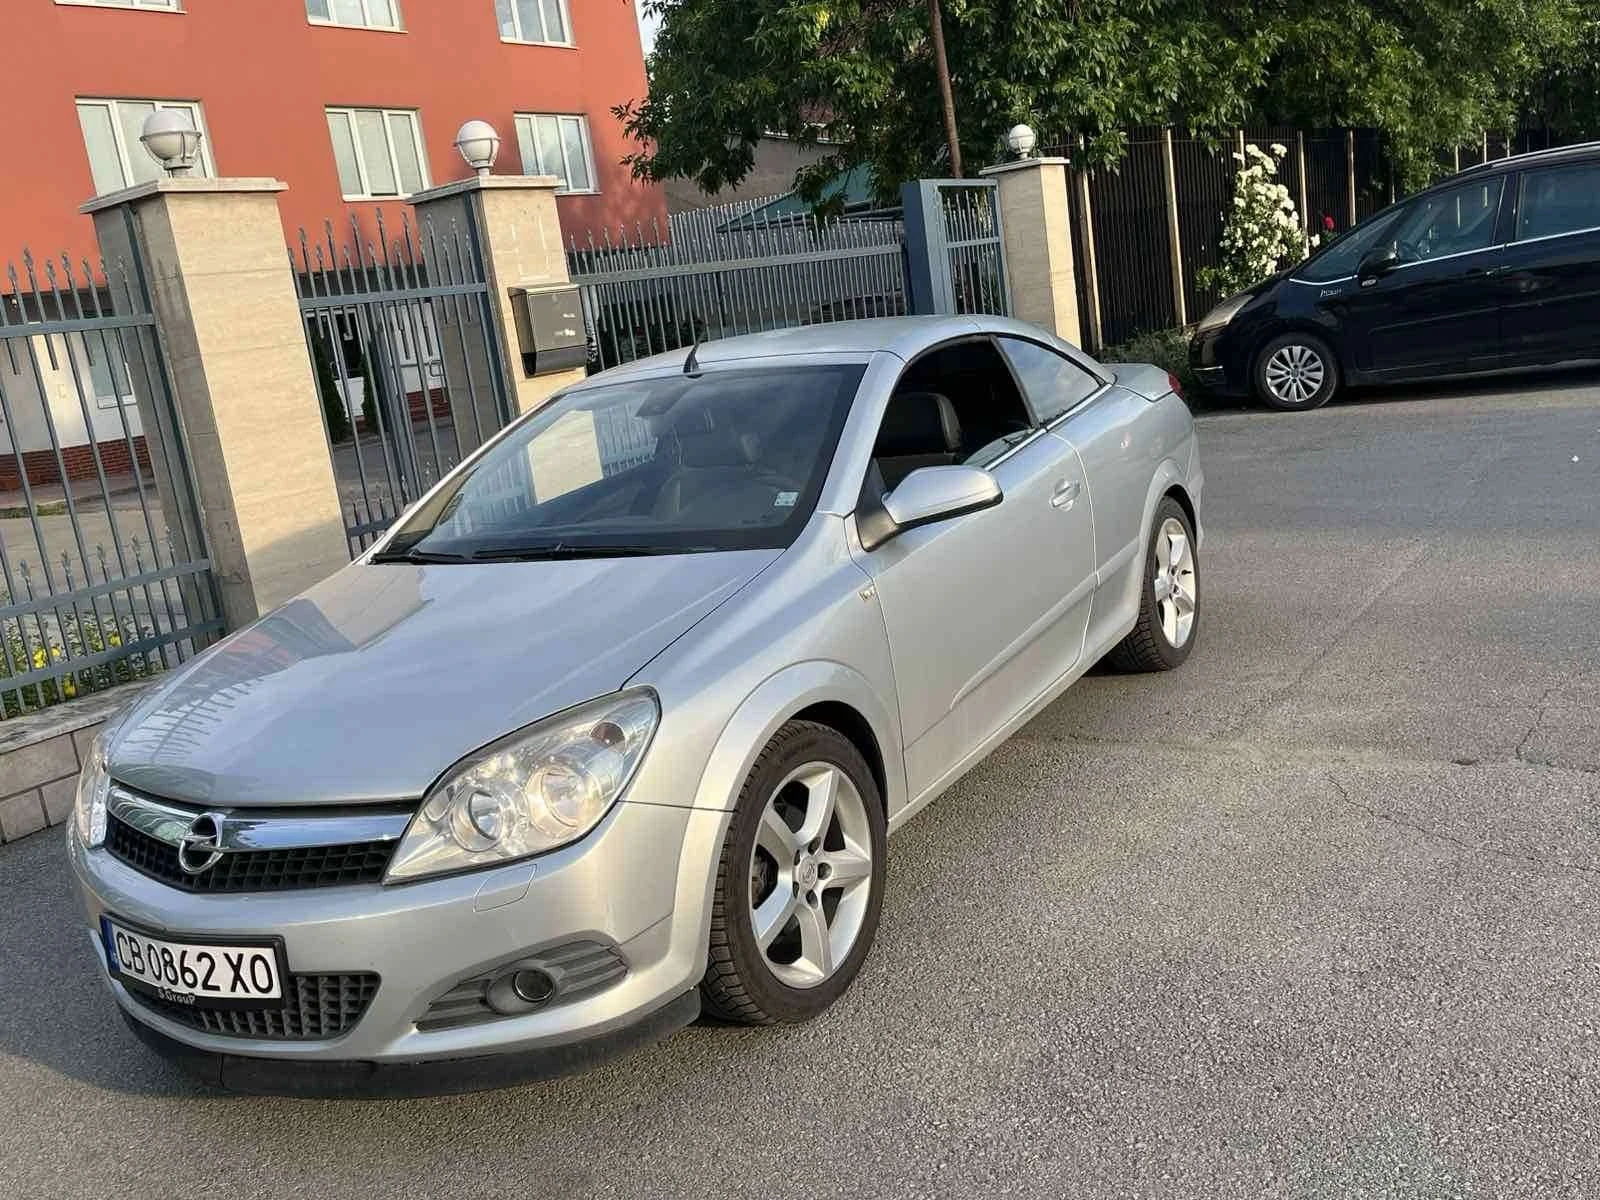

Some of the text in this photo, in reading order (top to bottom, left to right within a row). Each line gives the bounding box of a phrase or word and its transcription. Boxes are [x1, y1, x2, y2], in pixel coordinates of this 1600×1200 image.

[116, 931, 274, 994] CB 0862 XO
